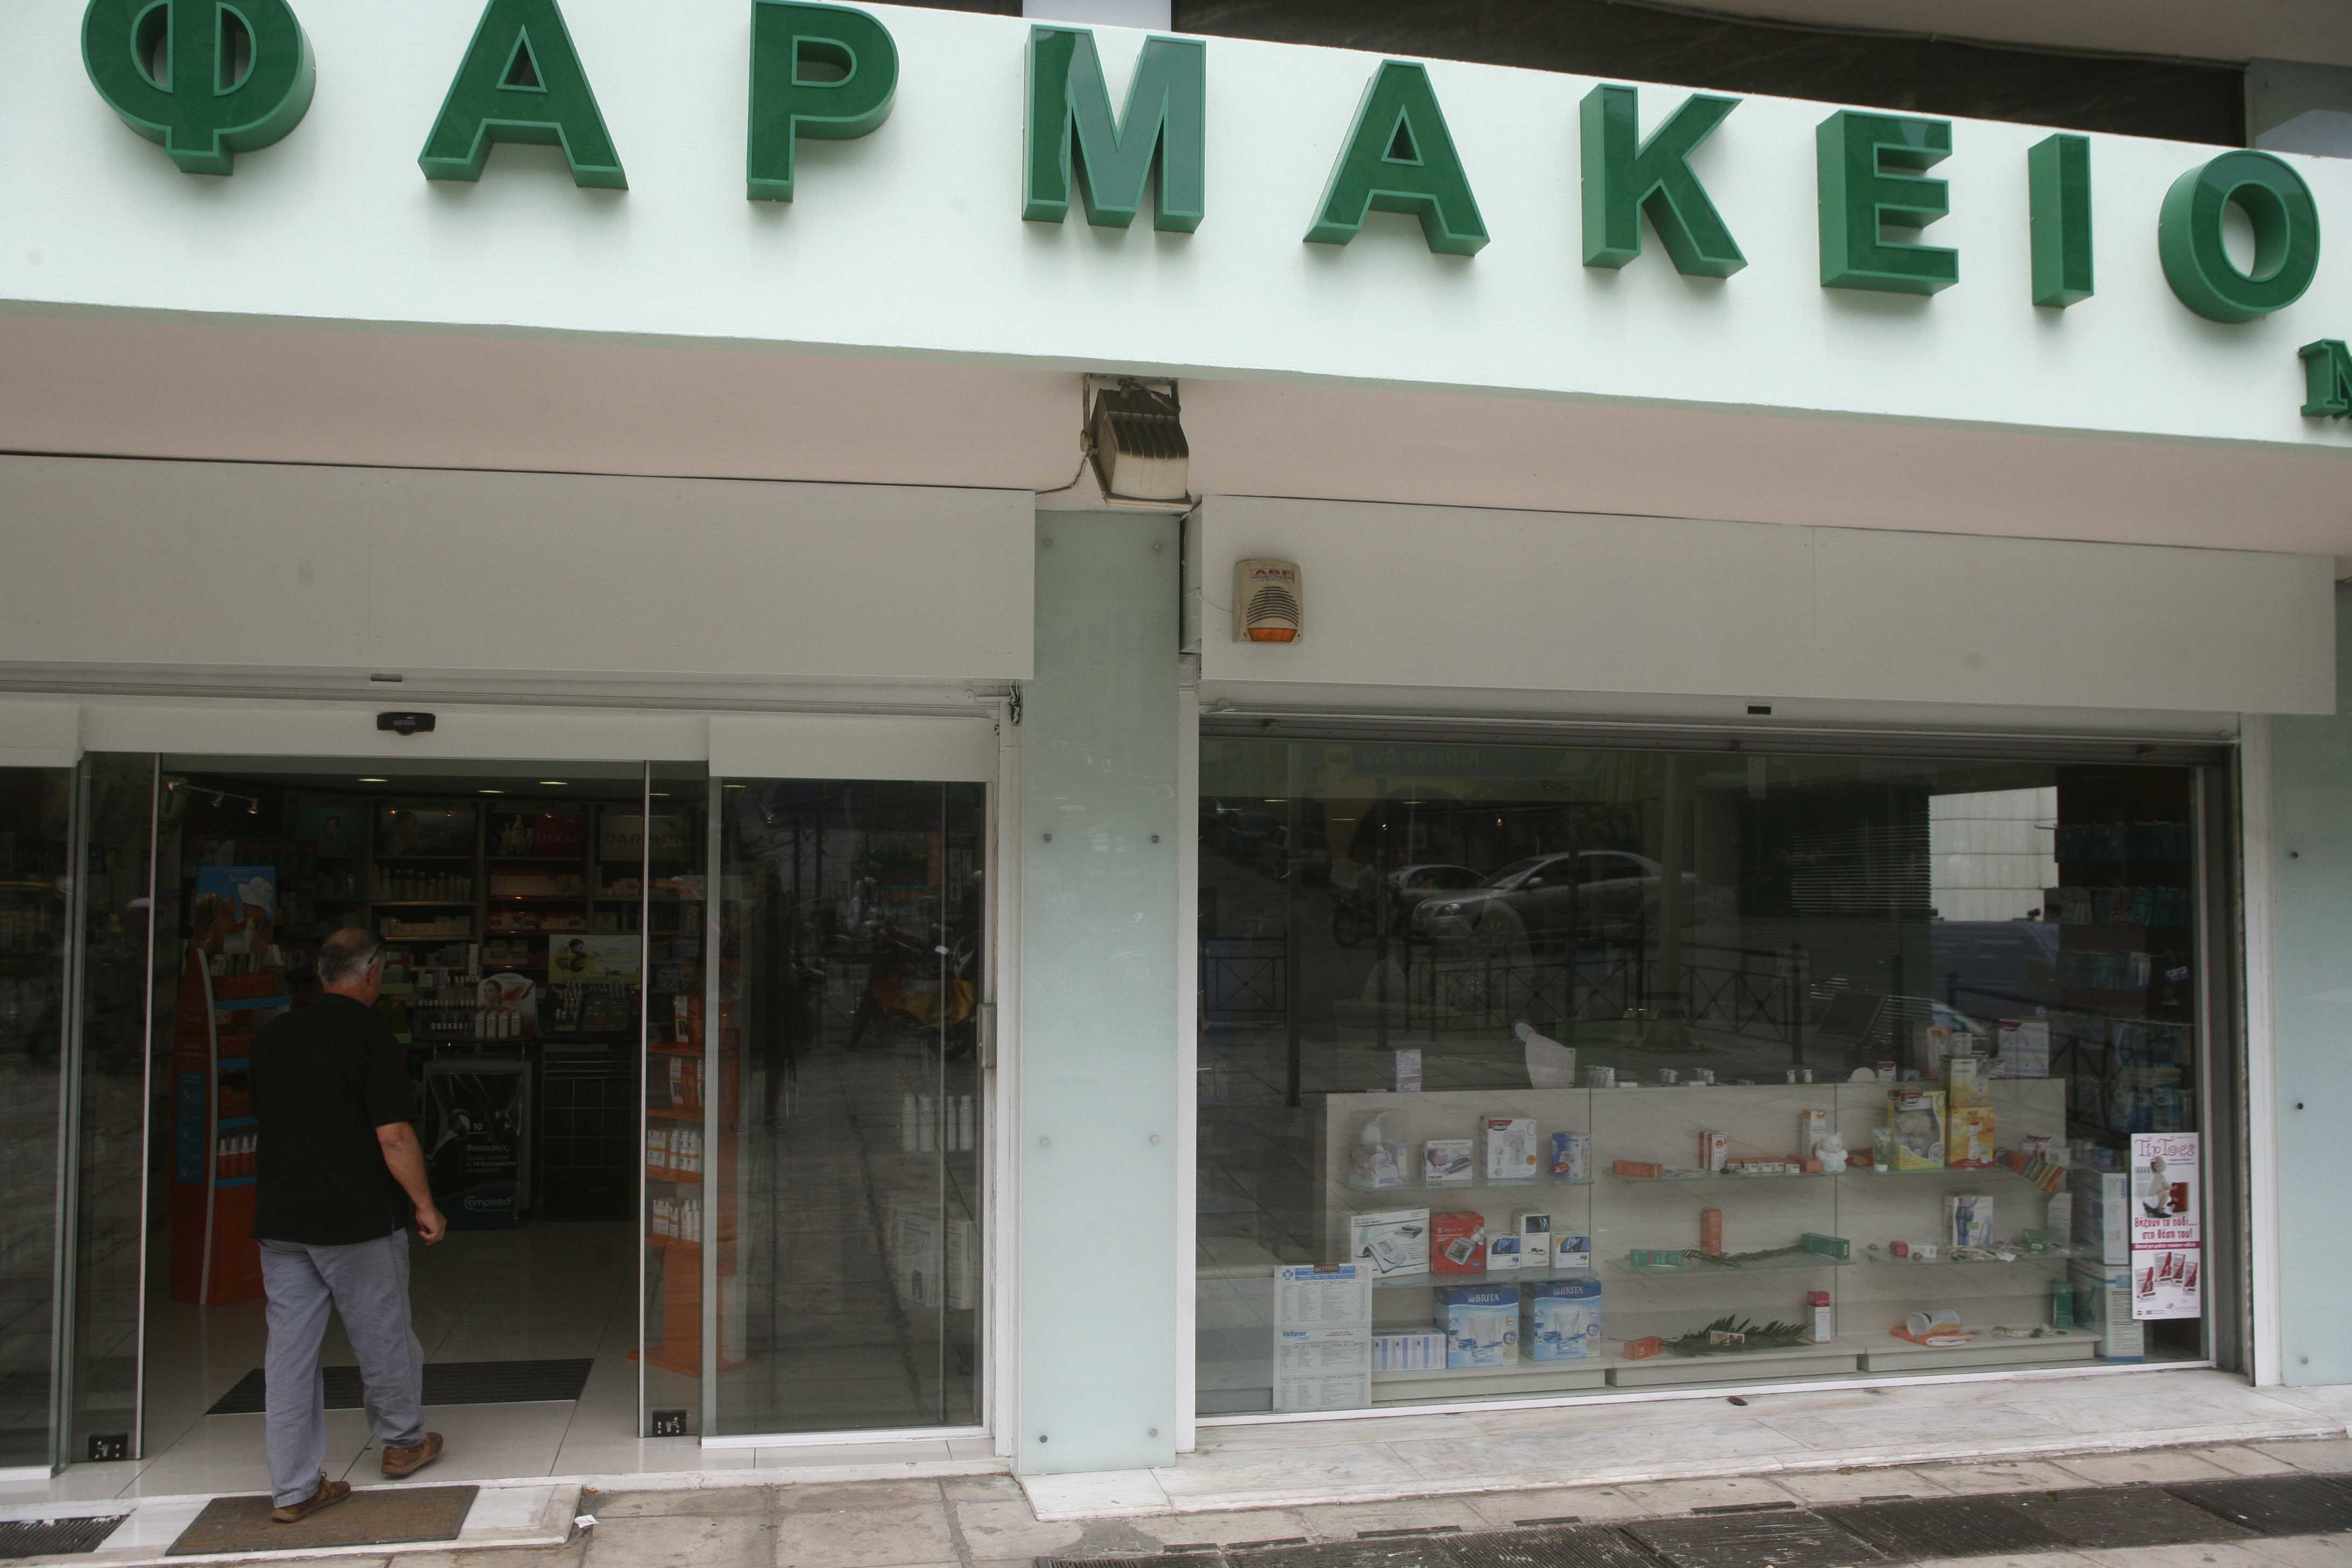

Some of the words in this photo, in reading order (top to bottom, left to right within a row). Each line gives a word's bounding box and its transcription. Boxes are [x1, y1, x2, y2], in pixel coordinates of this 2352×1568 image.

[464, 1196, 512, 1210] Compeed
[1560, 1286, 1584, 1295] BRITA
[1475, 1293, 1500, 1303] BRITA
